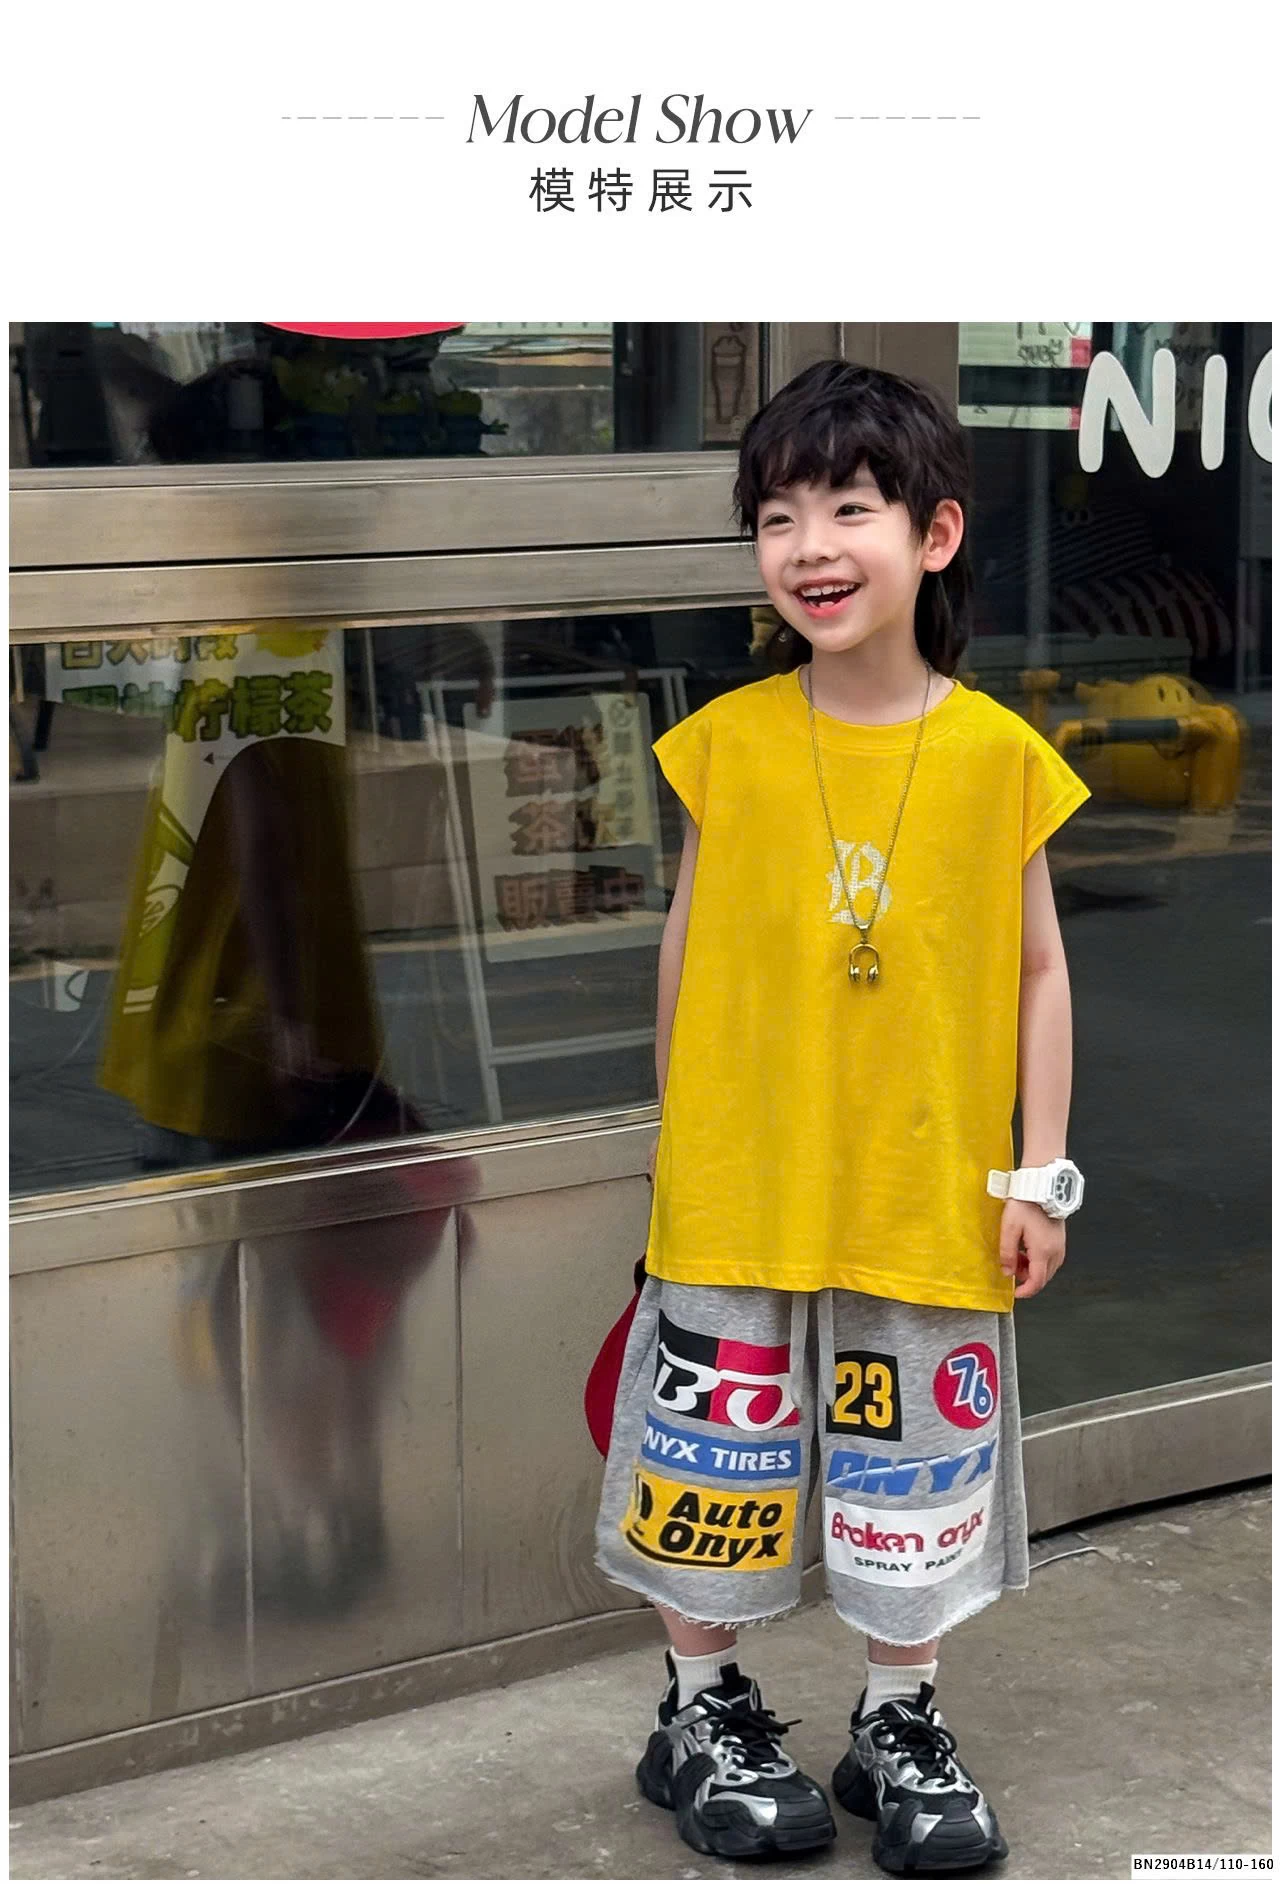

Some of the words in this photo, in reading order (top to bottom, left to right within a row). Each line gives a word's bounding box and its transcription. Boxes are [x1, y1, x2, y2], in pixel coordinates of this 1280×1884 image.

[834, 1361, 894, 1429] 23
[947, 1353, 994, 1418] 76
[711, 1446, 792, 1471] TIRES
[827, 1436, 997, 1496] ONYX
[667, 1491, 782, 1529] Auto
[831, 1511, 924, 1553] Broken
[658, 1520, 783, 1568] Onyx
[854, 1556, 913, 1572] SPRAY
